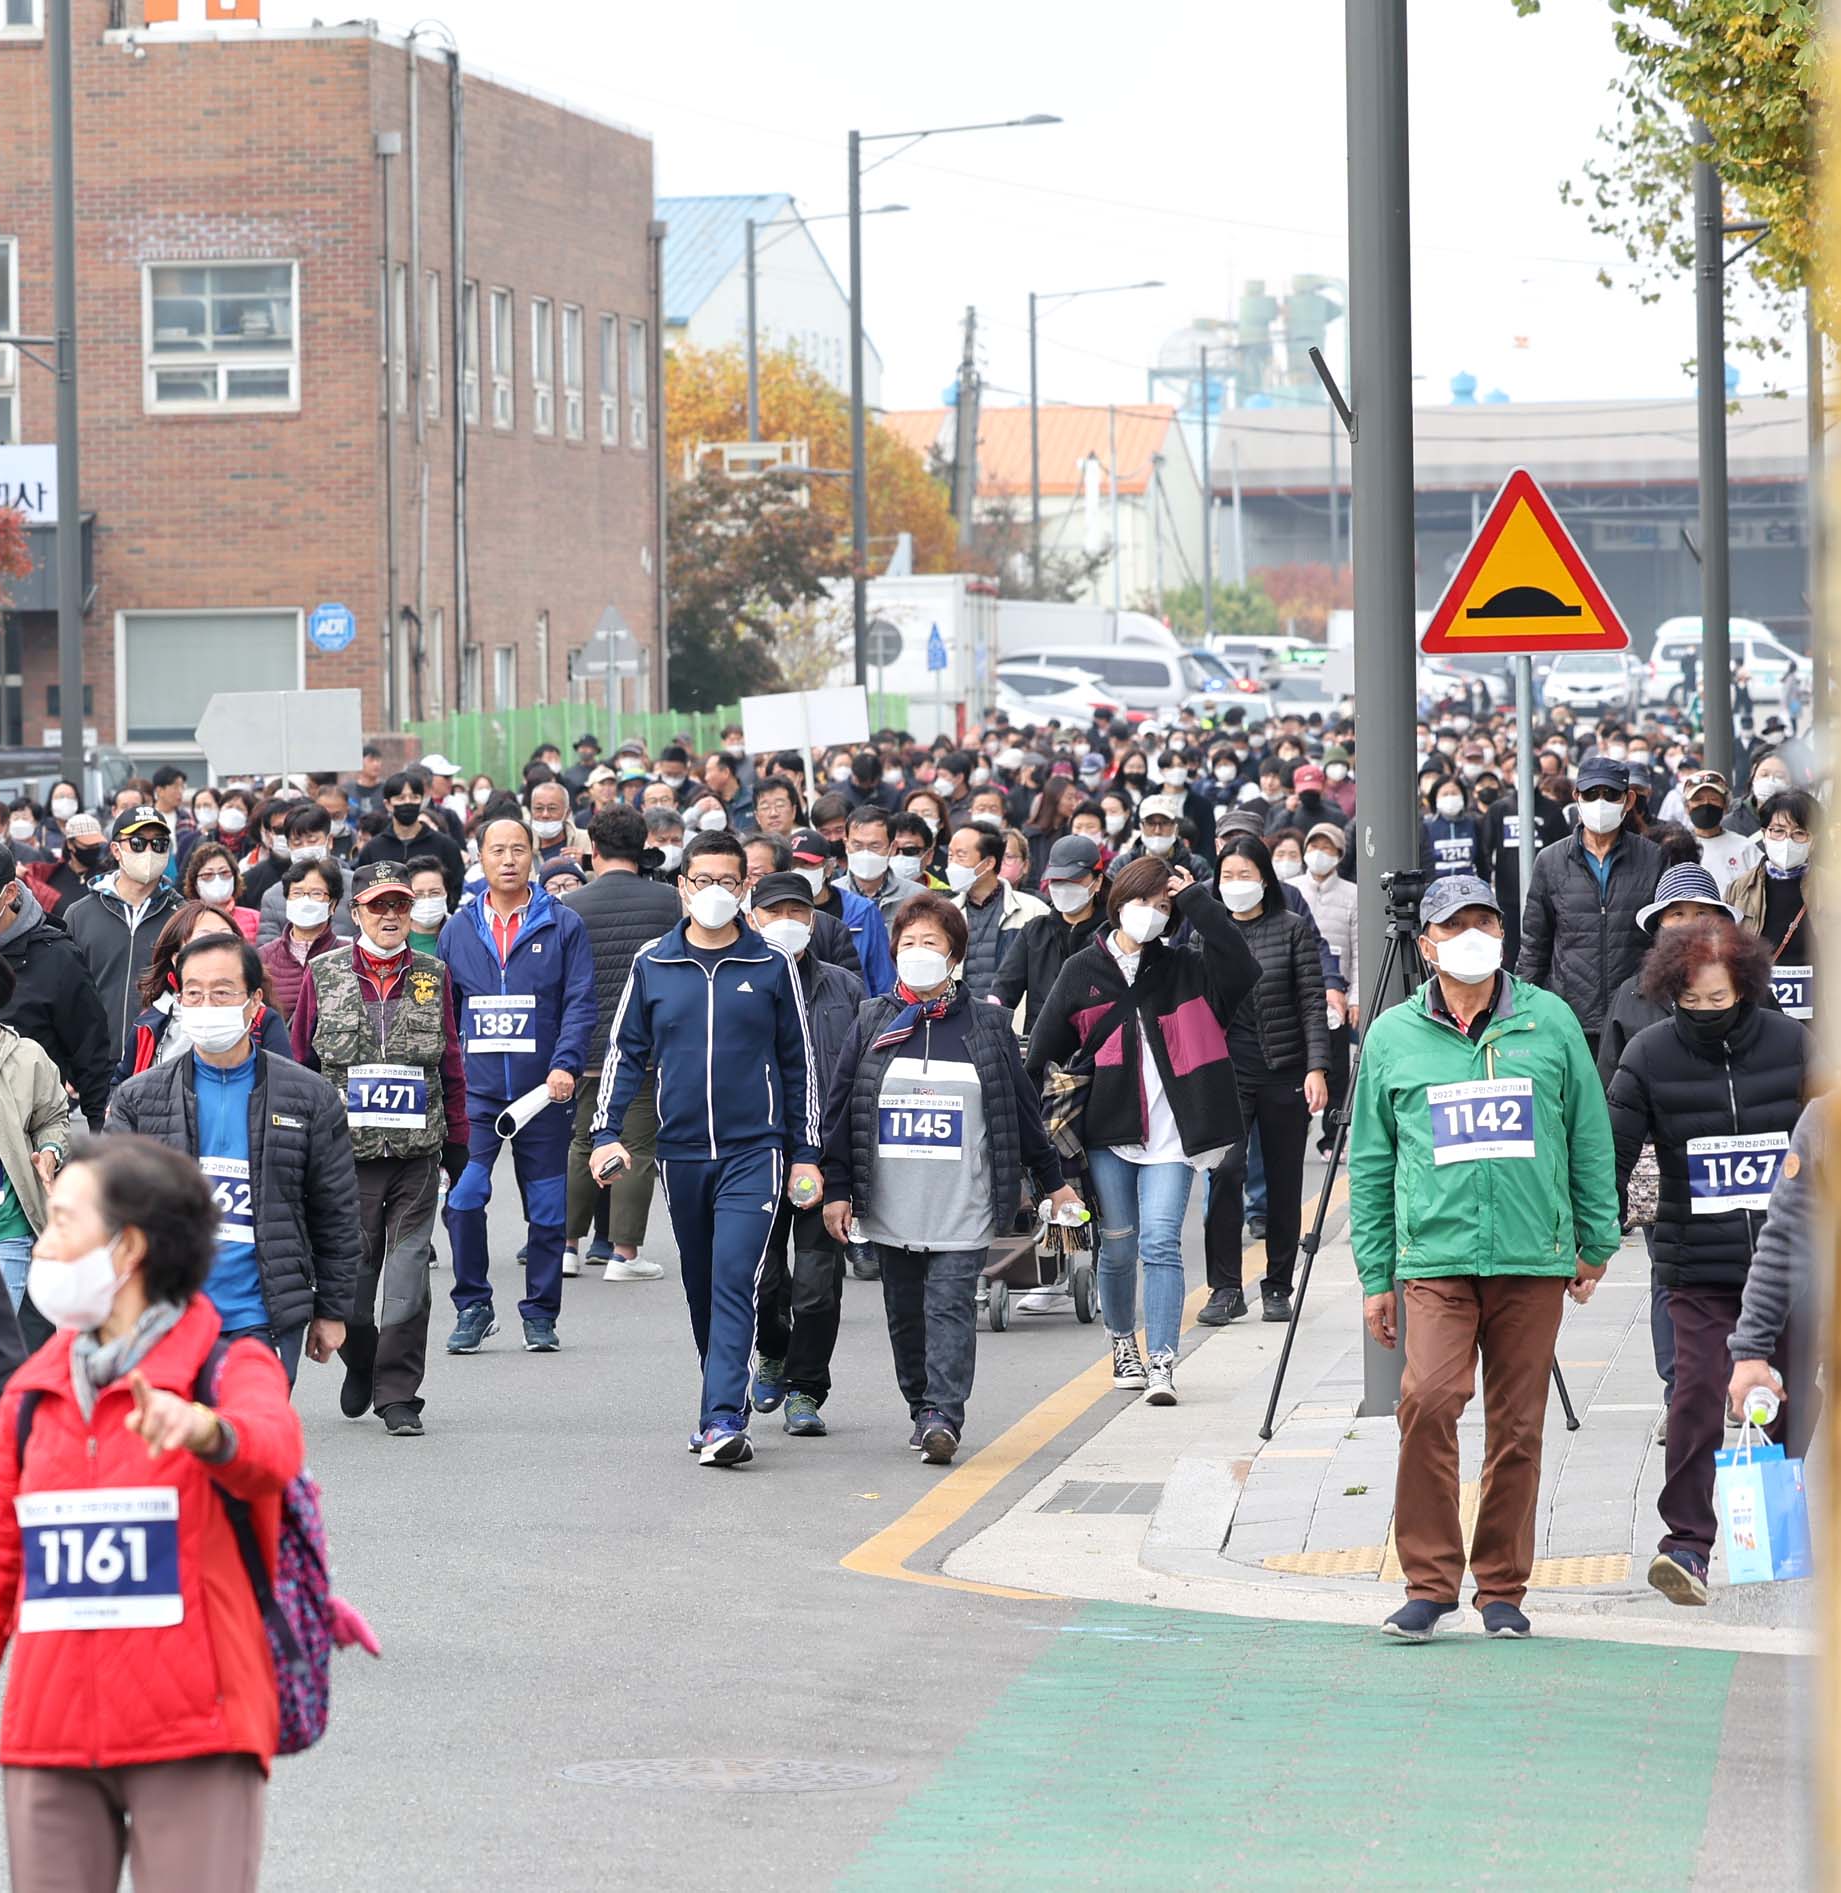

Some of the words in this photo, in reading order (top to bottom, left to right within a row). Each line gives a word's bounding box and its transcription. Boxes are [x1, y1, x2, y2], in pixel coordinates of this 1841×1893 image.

[316, 618, 347, 634] ADT
[473, 1013, 529, 1035] 1387
[359, 1084, 414, 1109] 1471
[890, 1112, 952, 1139] 1145
[1444, 1100, 1522, 1135] 1142
[1691, 1143, 1712, 1151] 2022
[1703, 1155, 1776, 1188] 1167
[39, 1527, 148, 1585] 1161
